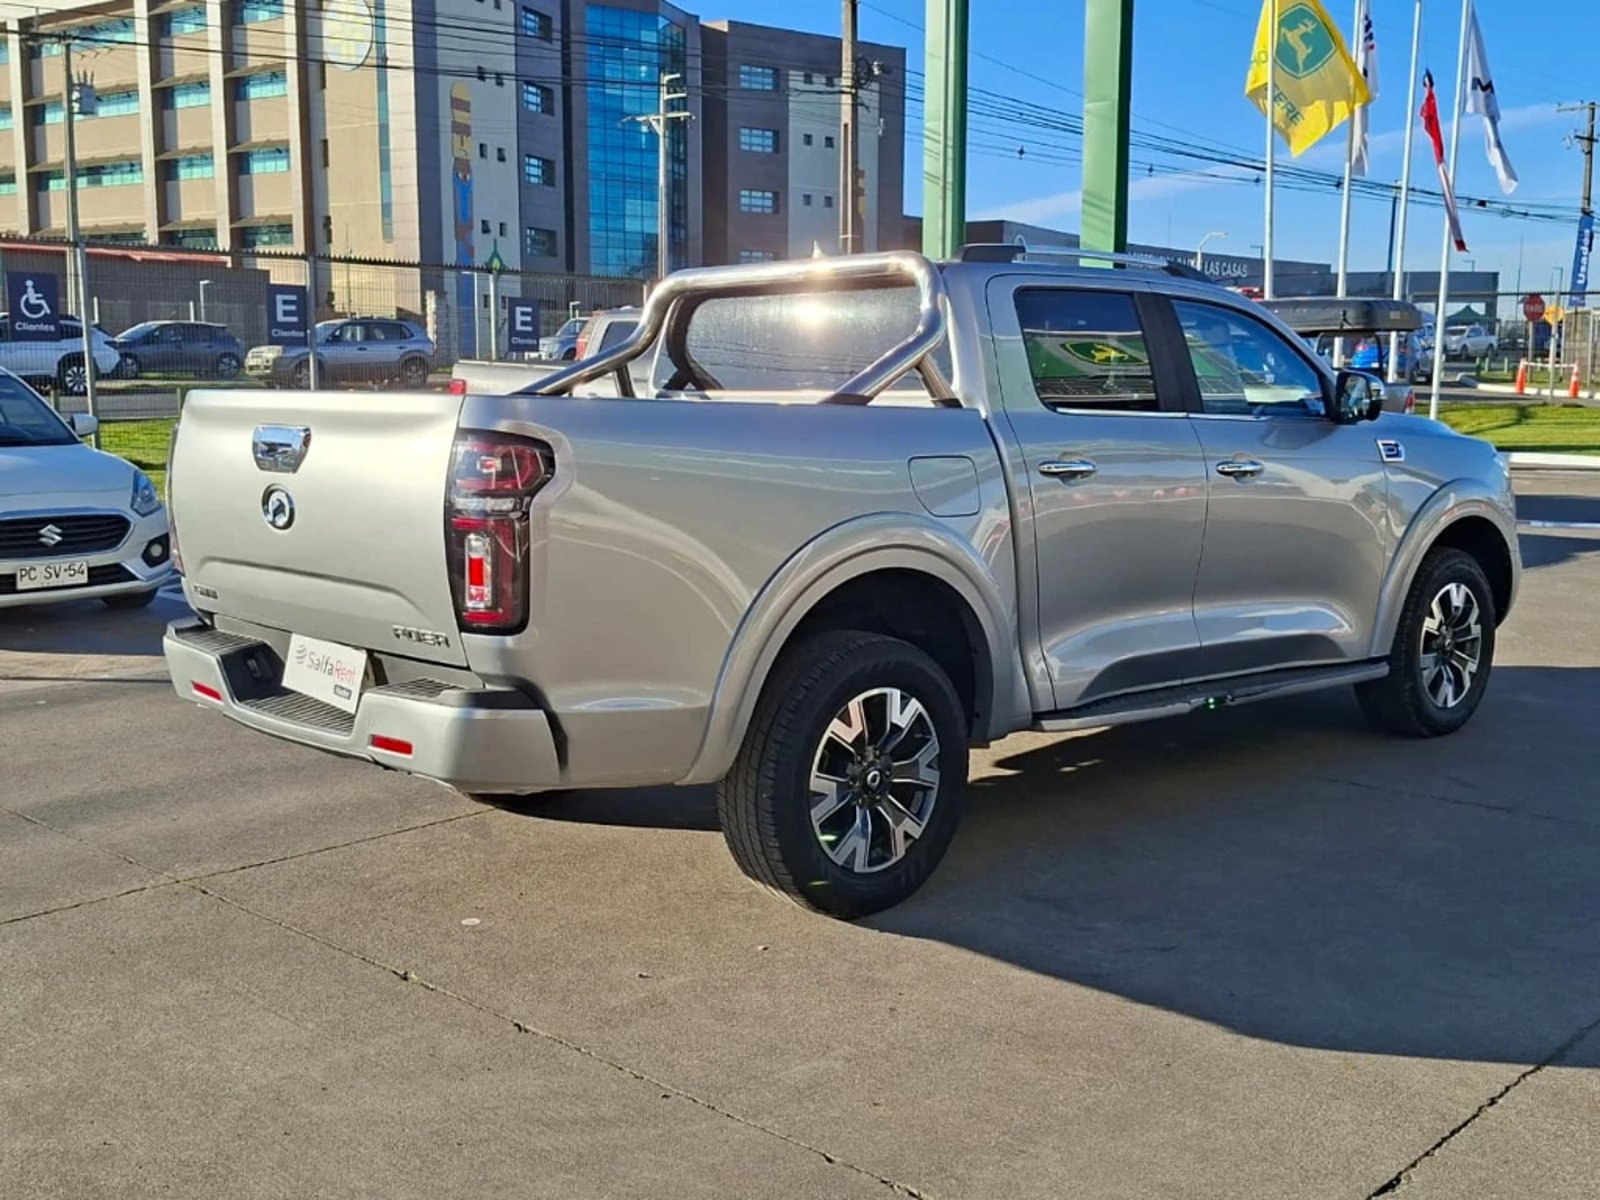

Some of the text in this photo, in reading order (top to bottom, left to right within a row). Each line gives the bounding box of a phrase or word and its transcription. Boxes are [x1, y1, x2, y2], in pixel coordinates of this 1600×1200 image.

[1204, 259, 1220, 276] LAS
[1221, 261, 1248, 278] CASAS
[275, 294, 299, 322] E
[15, 321, 56, 332] Clientes
[515, 306, 533, 331] E
[20, 566, 37, 582] PC
